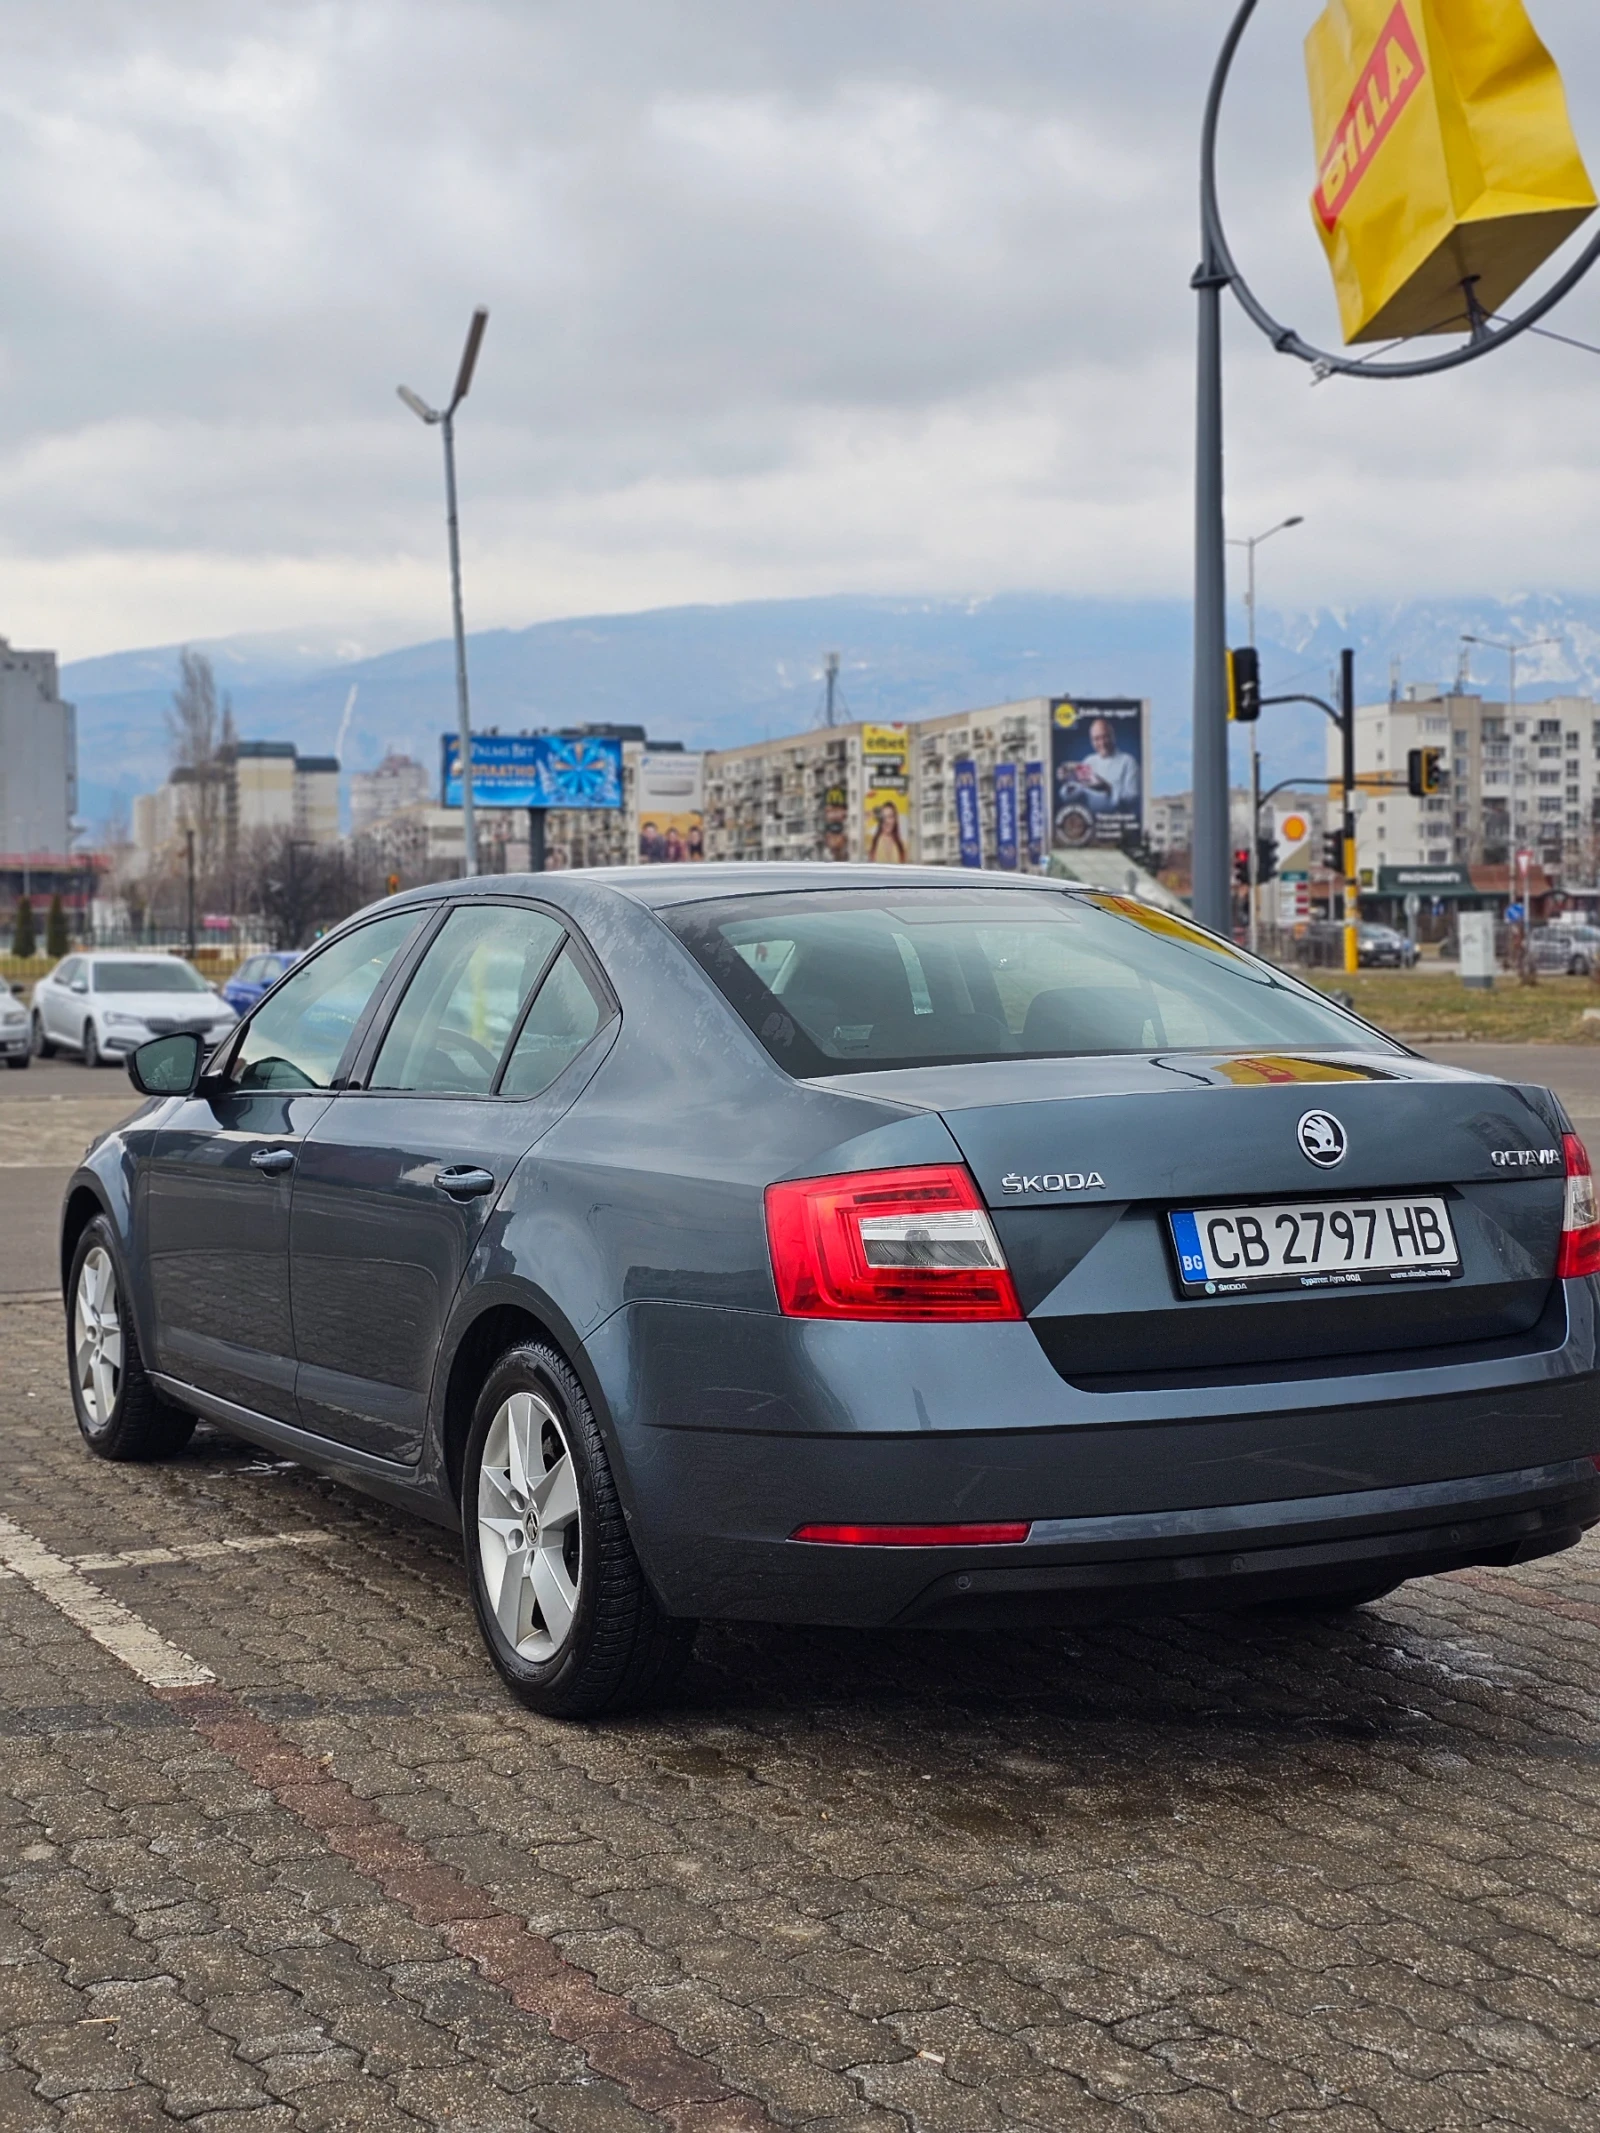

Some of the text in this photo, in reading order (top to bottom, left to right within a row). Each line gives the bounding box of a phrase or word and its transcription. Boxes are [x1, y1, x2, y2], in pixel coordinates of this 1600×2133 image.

[1321, 36, 1415, 211] BILLA
[1491, 1149, 1561, 1166] OCTAVIA
[1001, 1172, 1107, 1194] ŠKODA
[1207, 1206, 1446, 1269] CB 2797 HB
[1183, 1254, 1203, 1271] BG
